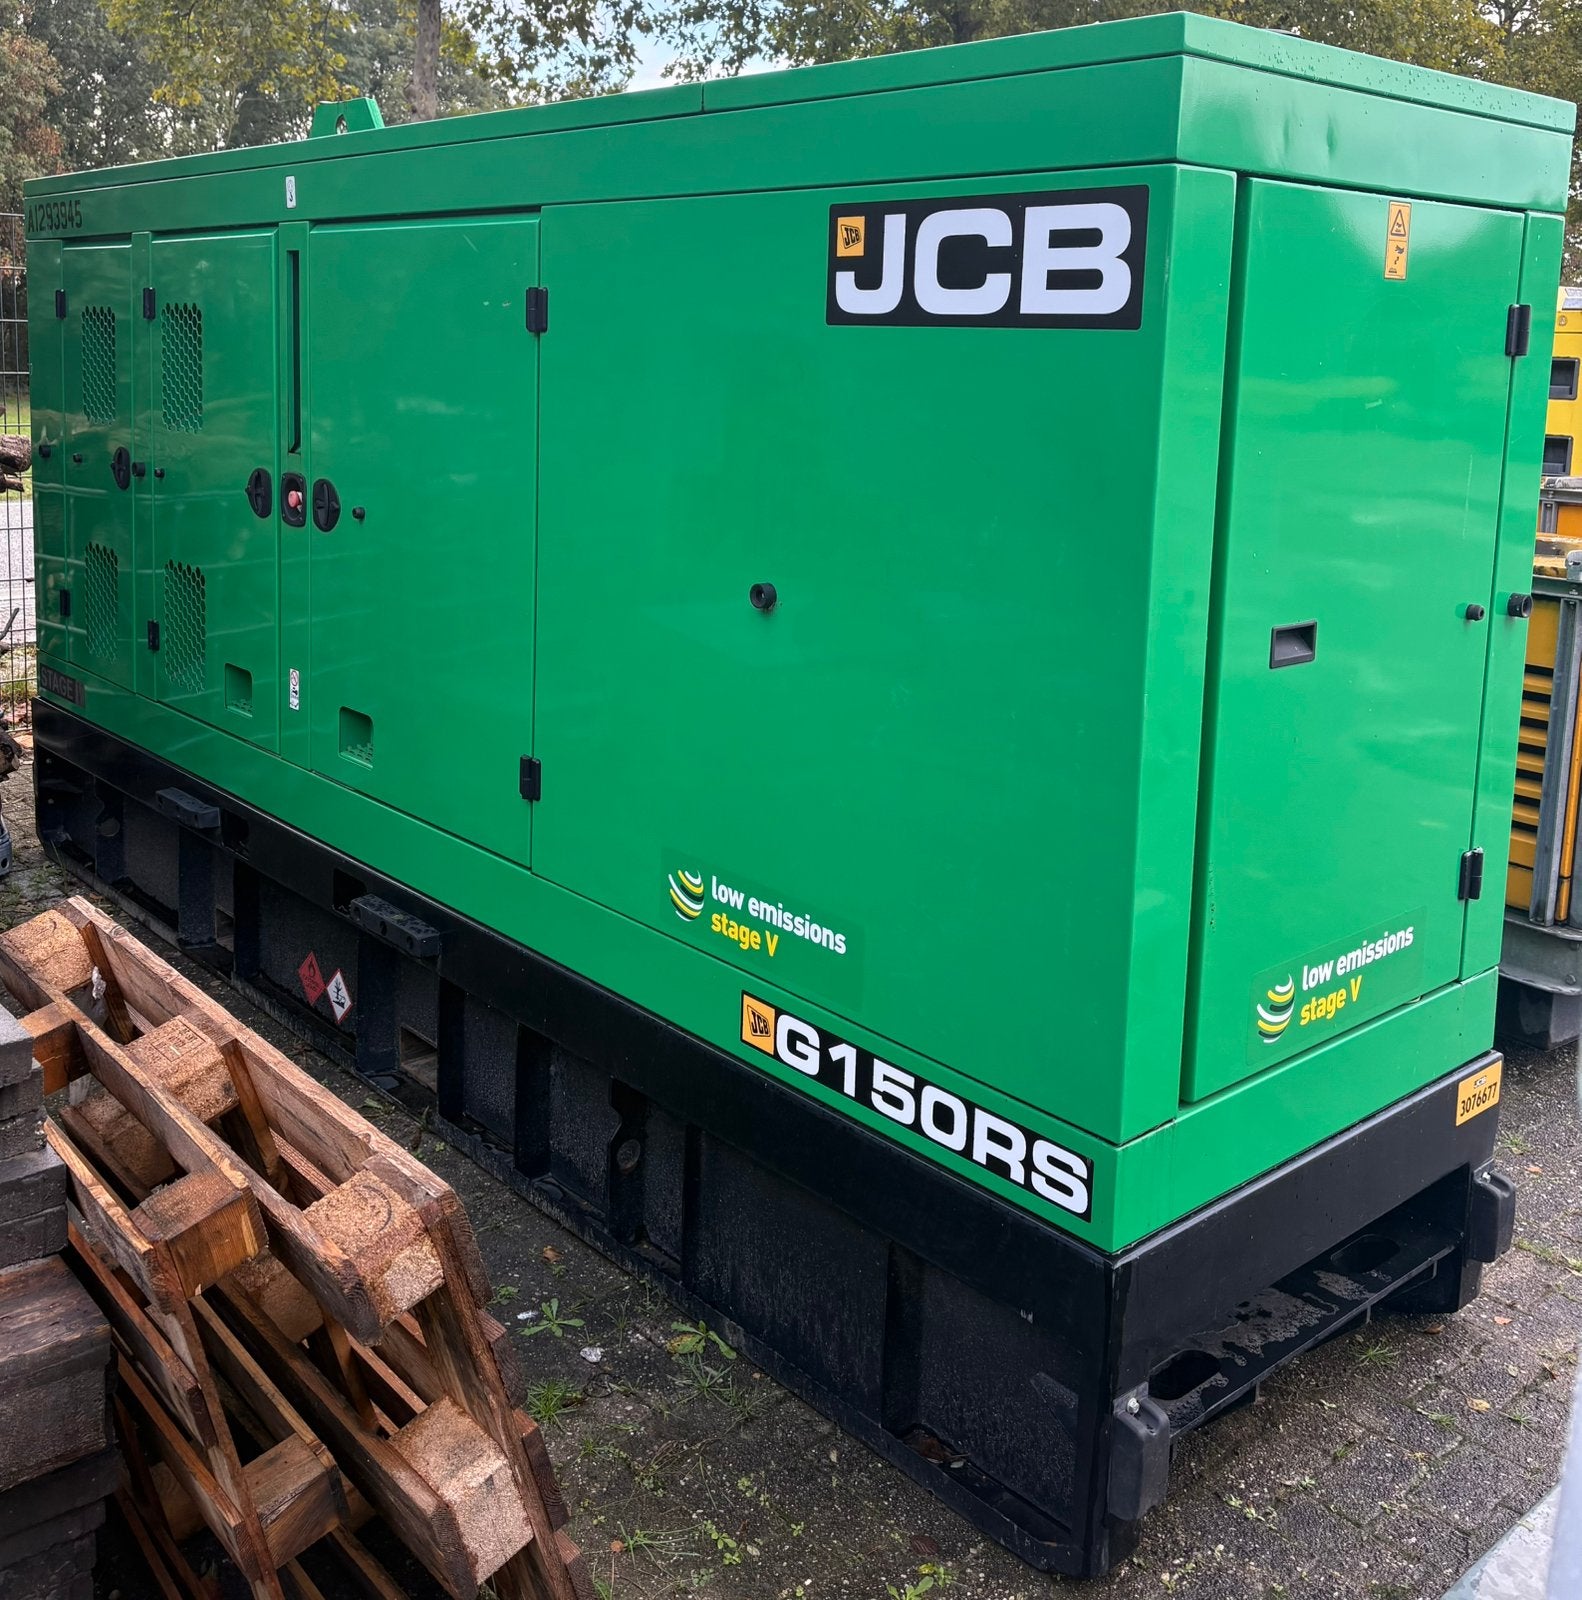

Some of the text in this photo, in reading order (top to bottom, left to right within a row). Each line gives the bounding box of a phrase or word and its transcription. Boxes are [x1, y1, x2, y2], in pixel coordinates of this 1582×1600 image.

[835, 202, 1132, 315] JCB
[844, 227, 860, 247] JCB
[41, 667, 74, 700] STAGE
[711, 875, 847, 955] low emissions
[711, 912, 779, 957] stage V
[1302, 926, 1414, 991] low emissions
[751, 1010, 769, 1035] JCB
[1300, 975, 1362, 1026] stage V
[776, 1014, 1089, 1214] G150RS
[1460, 1081, 1497, 1117] 3076677
